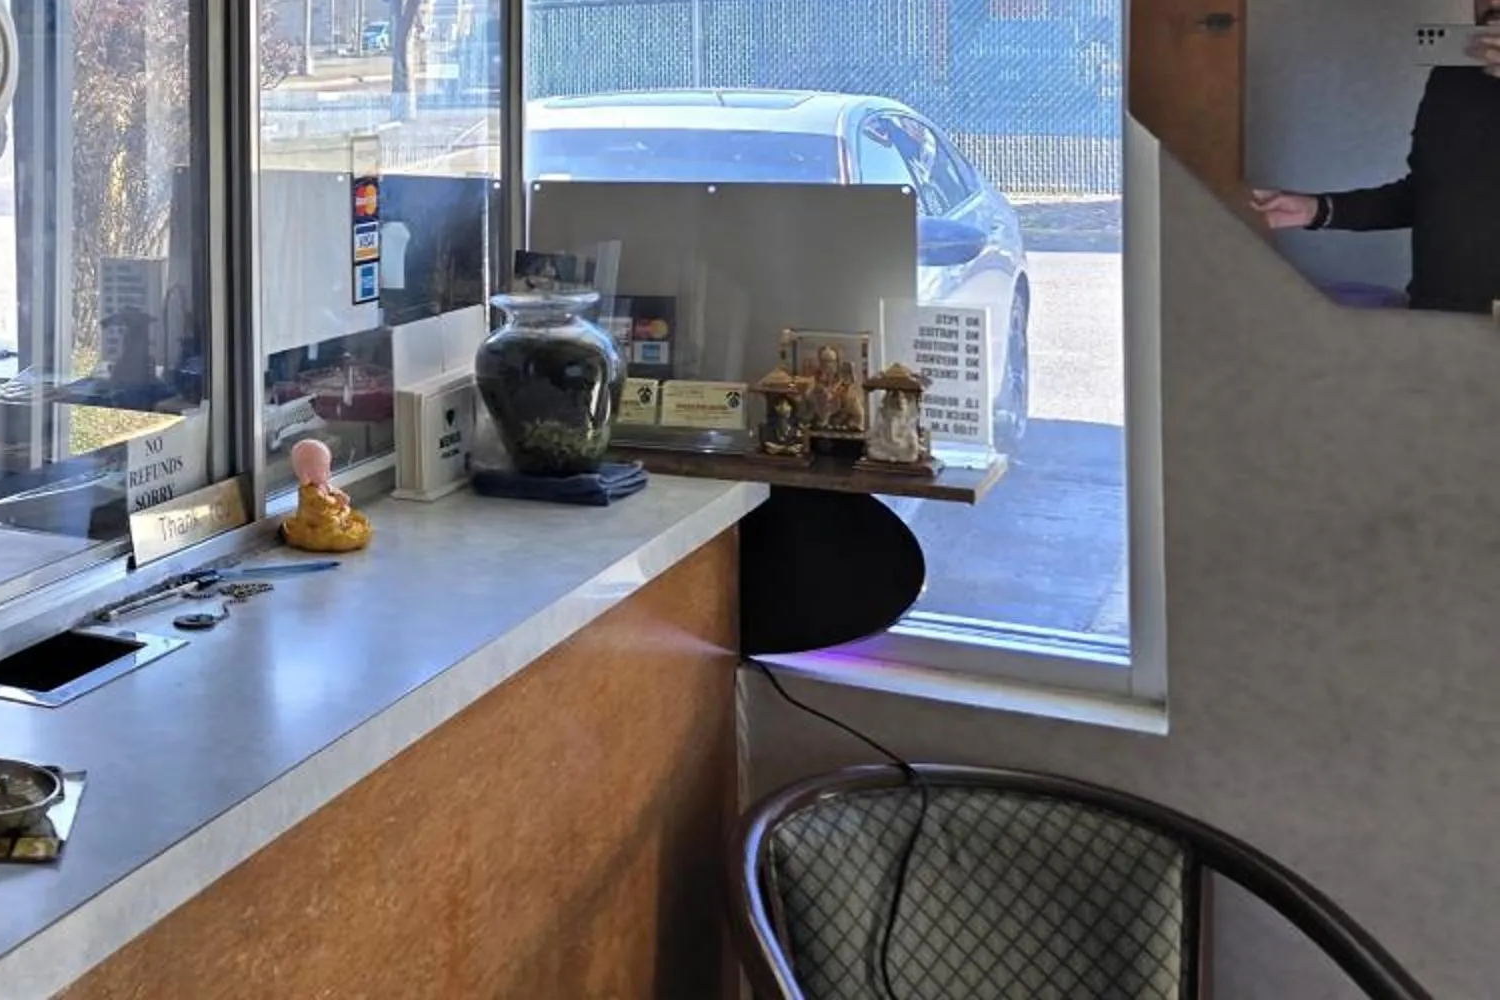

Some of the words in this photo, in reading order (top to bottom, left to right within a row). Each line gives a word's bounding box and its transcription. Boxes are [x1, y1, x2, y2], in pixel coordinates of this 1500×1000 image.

[144, 436, 164, 458] NO
[129, 455, 184, 489] REFUNDS
[133, 483, 175, 511] SORRY
